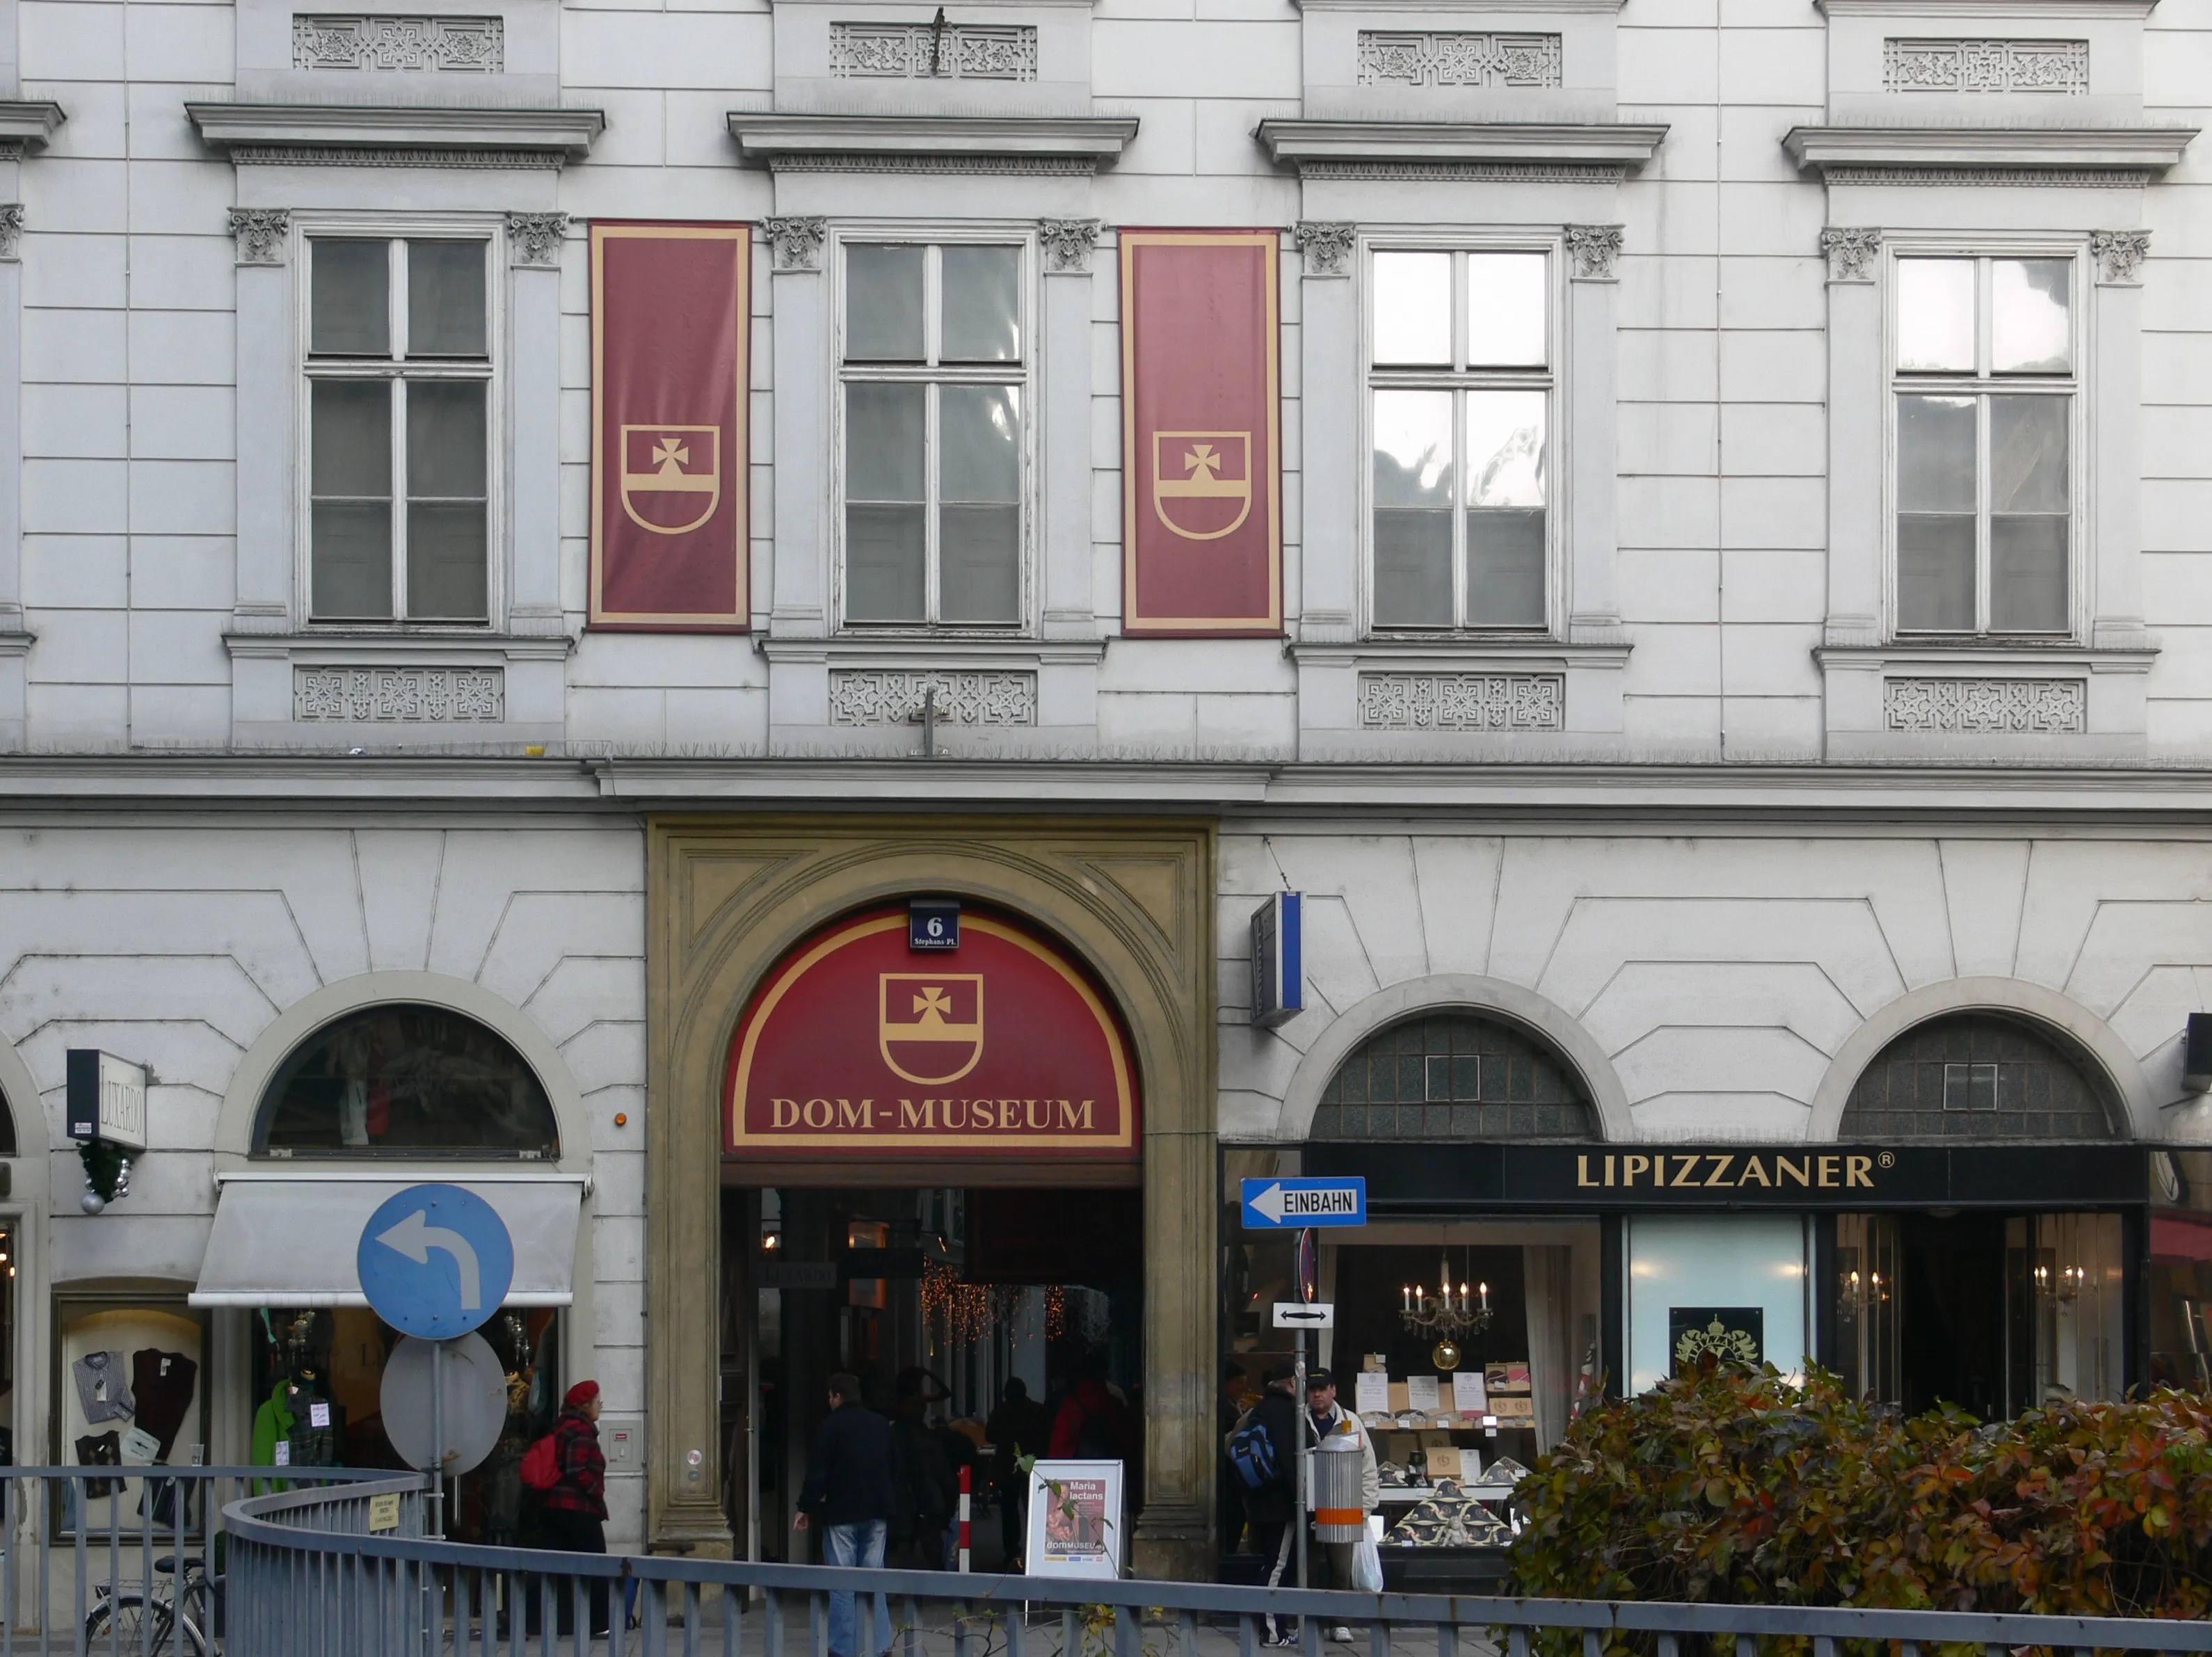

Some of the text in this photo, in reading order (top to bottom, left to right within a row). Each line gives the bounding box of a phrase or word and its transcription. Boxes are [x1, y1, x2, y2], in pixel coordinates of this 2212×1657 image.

[927, 918, 943, 937] 6
[100, 1064, 143, 1135] LUXARDO
[770, 1098, 1095, 1130] DOM-MUSEUM
[1284, 1191, 1353, 1213] EINBAHN
[1069, 1491, 1104, 1500] lactans
[1070, 1481, 1096, 1490] Maria
